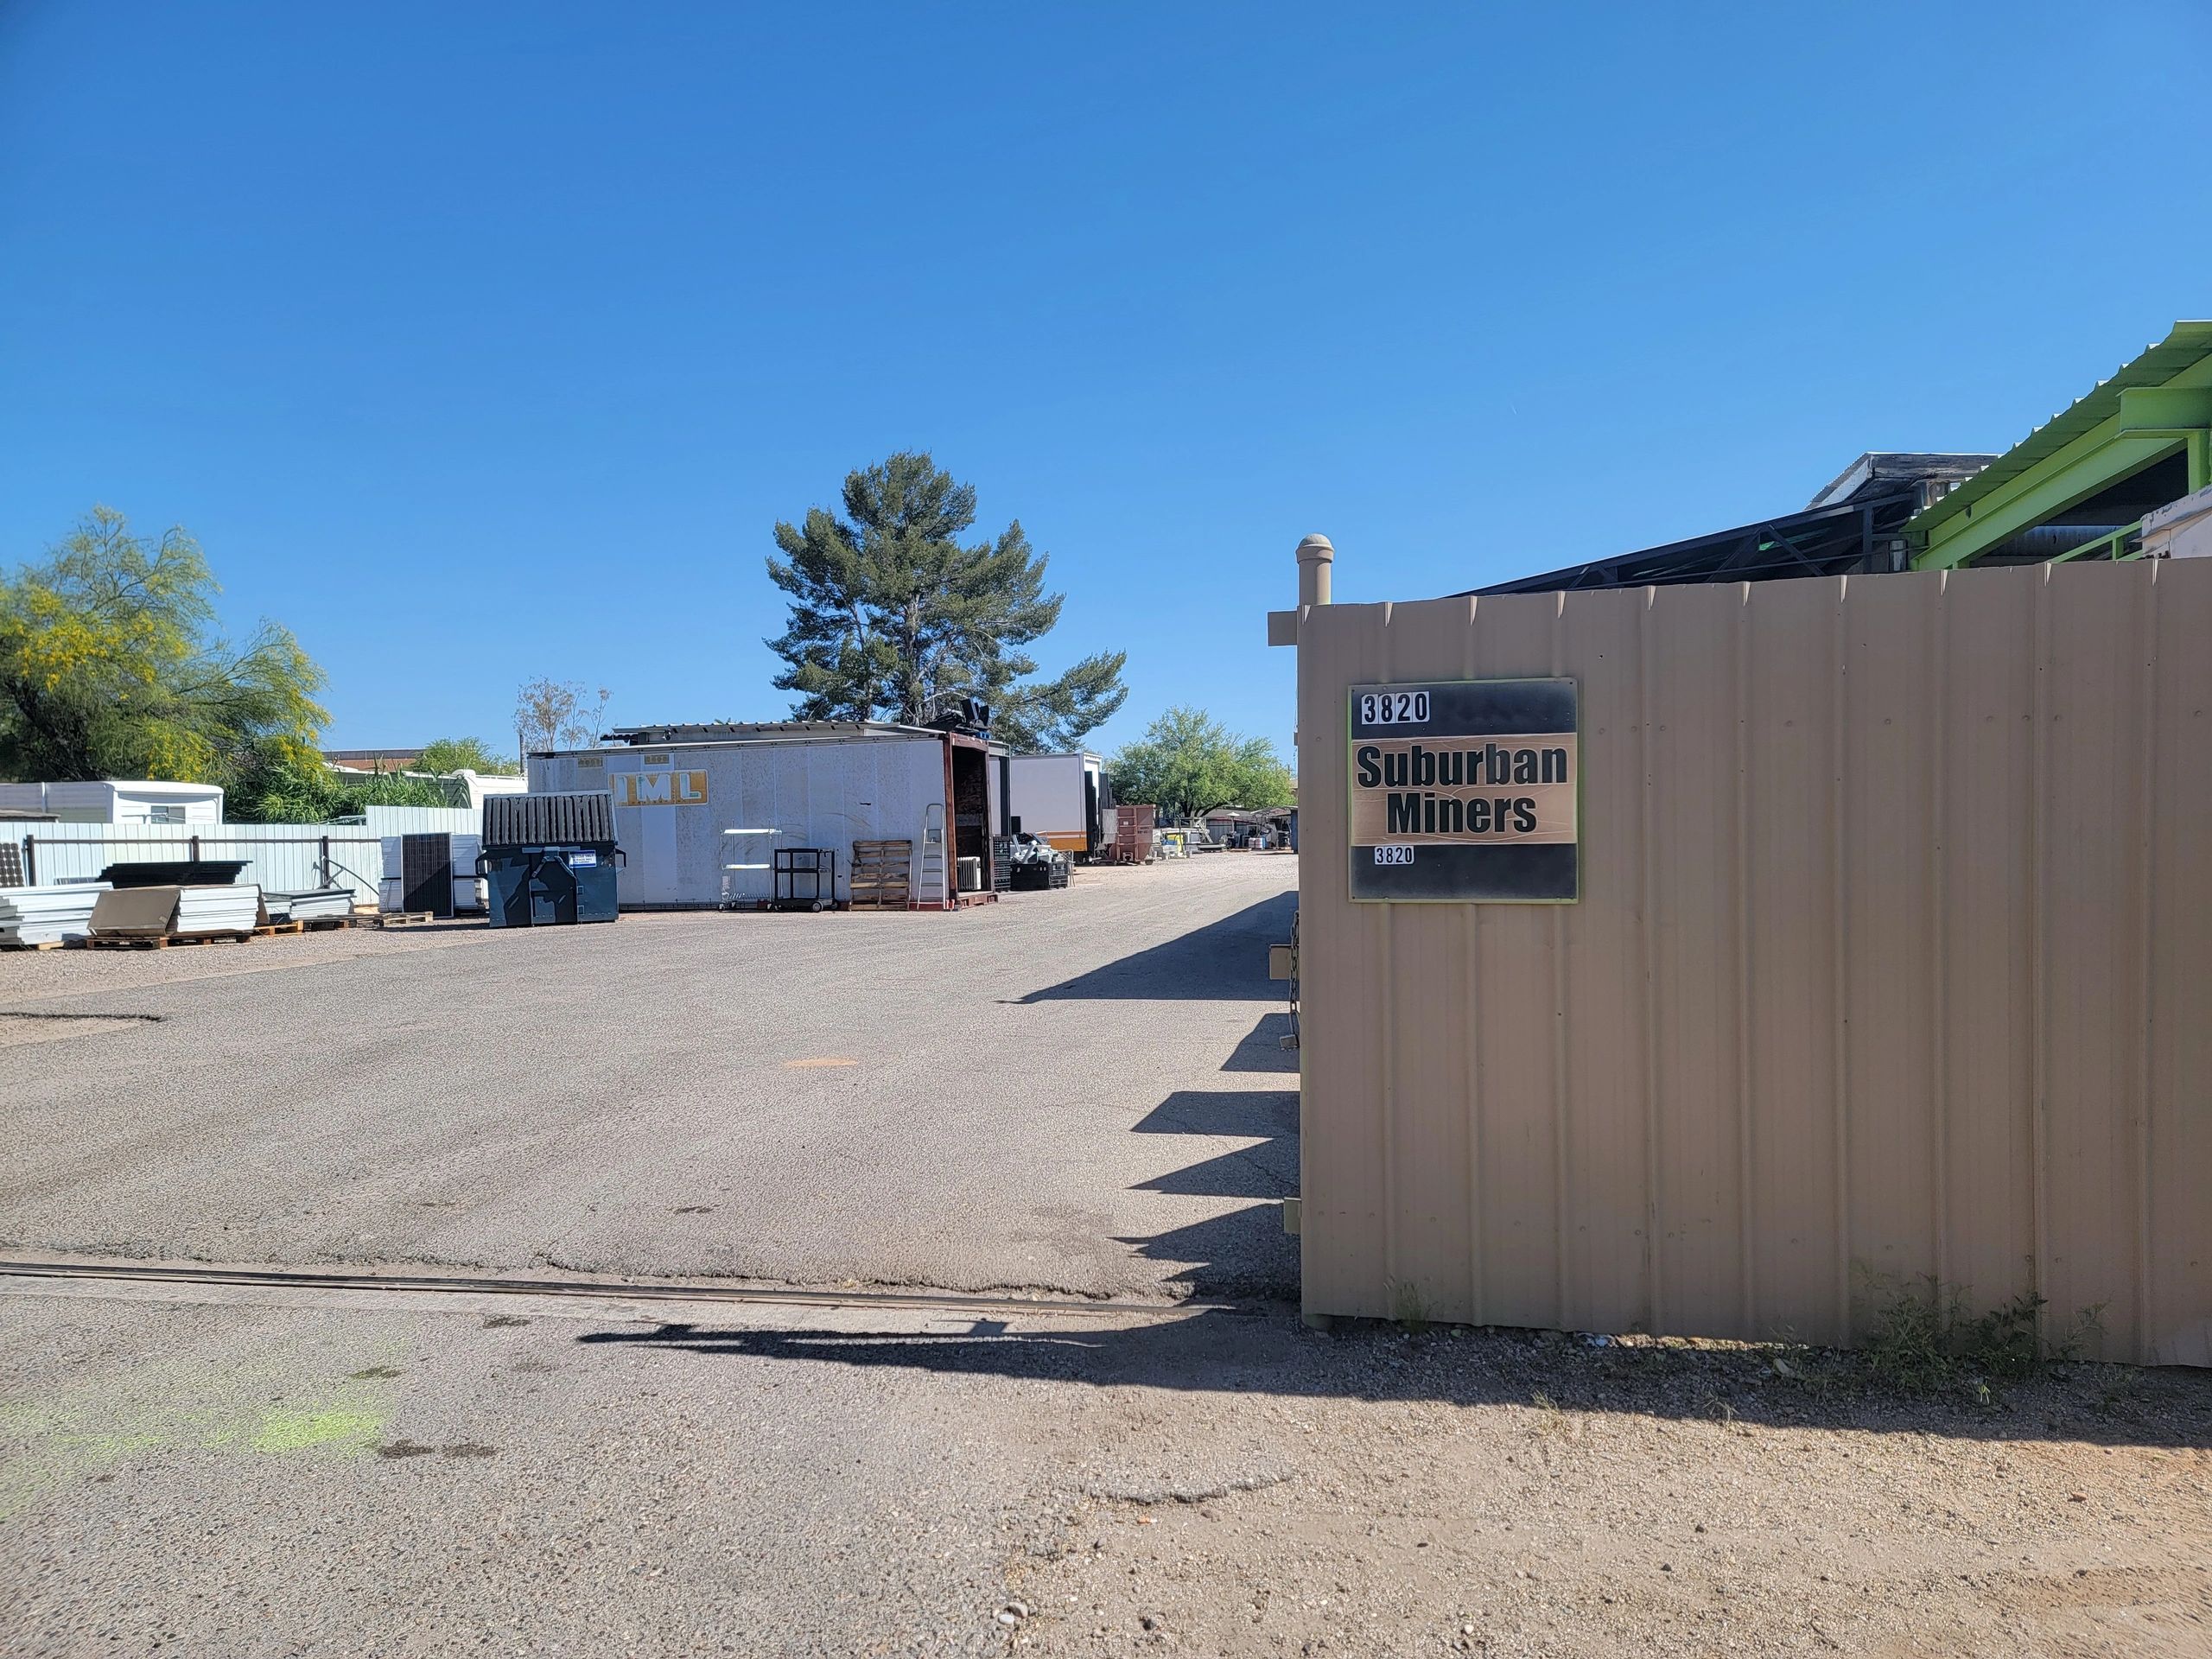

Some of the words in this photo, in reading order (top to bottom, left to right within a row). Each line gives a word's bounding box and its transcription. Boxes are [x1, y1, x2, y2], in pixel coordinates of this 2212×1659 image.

[1364, 694, 1427, 722] 3820
[1357, 742, 1567, 787] Suburban
[1387, 792, 1536, 834] Miners
[1376, 846, 1413, 863] 3820
